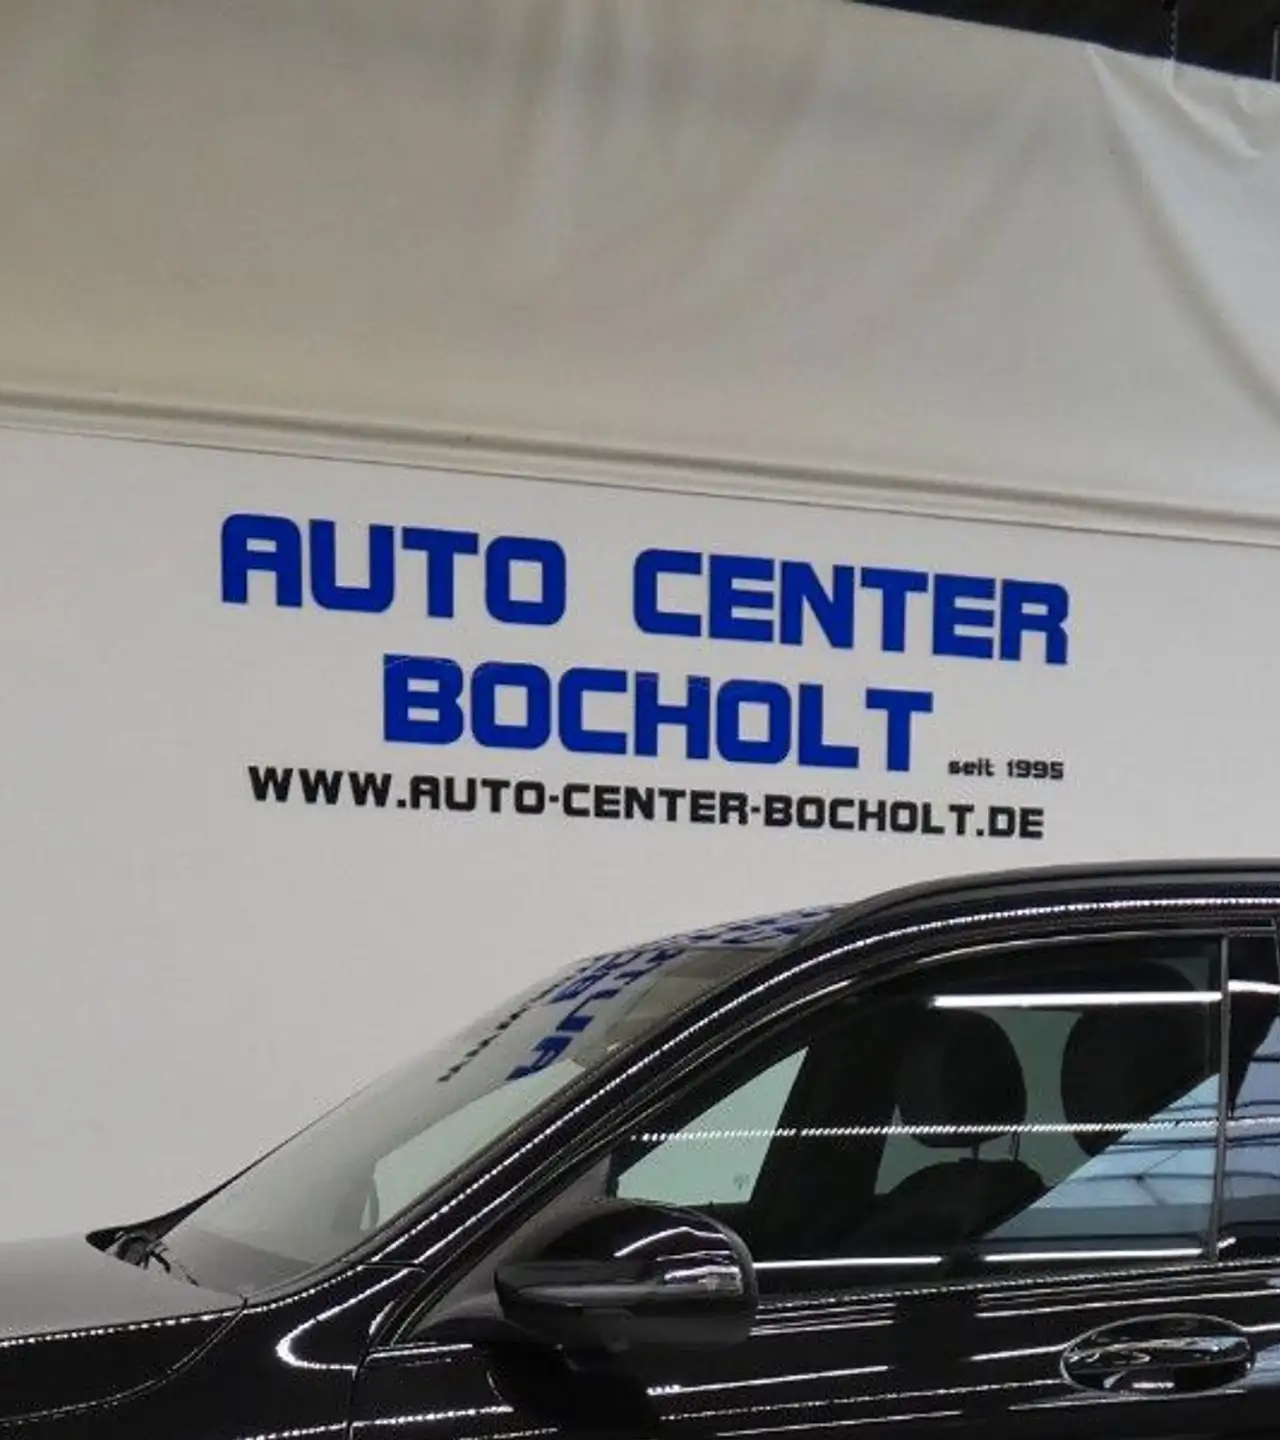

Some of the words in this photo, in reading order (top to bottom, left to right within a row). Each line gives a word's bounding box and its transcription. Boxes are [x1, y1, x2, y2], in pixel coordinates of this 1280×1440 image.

[221, 513, 568, 627] AUTO
[634, 549, 1070, 665] CENTER
[383, 654, 933, 772] BOCHOLT
[249, 765, 1045, 839] WWW.AUTO-CENTER-BOCHOLT.DE
[948, 758, 995, 777] seit
[1007, 760, 1064, 780] 1995
